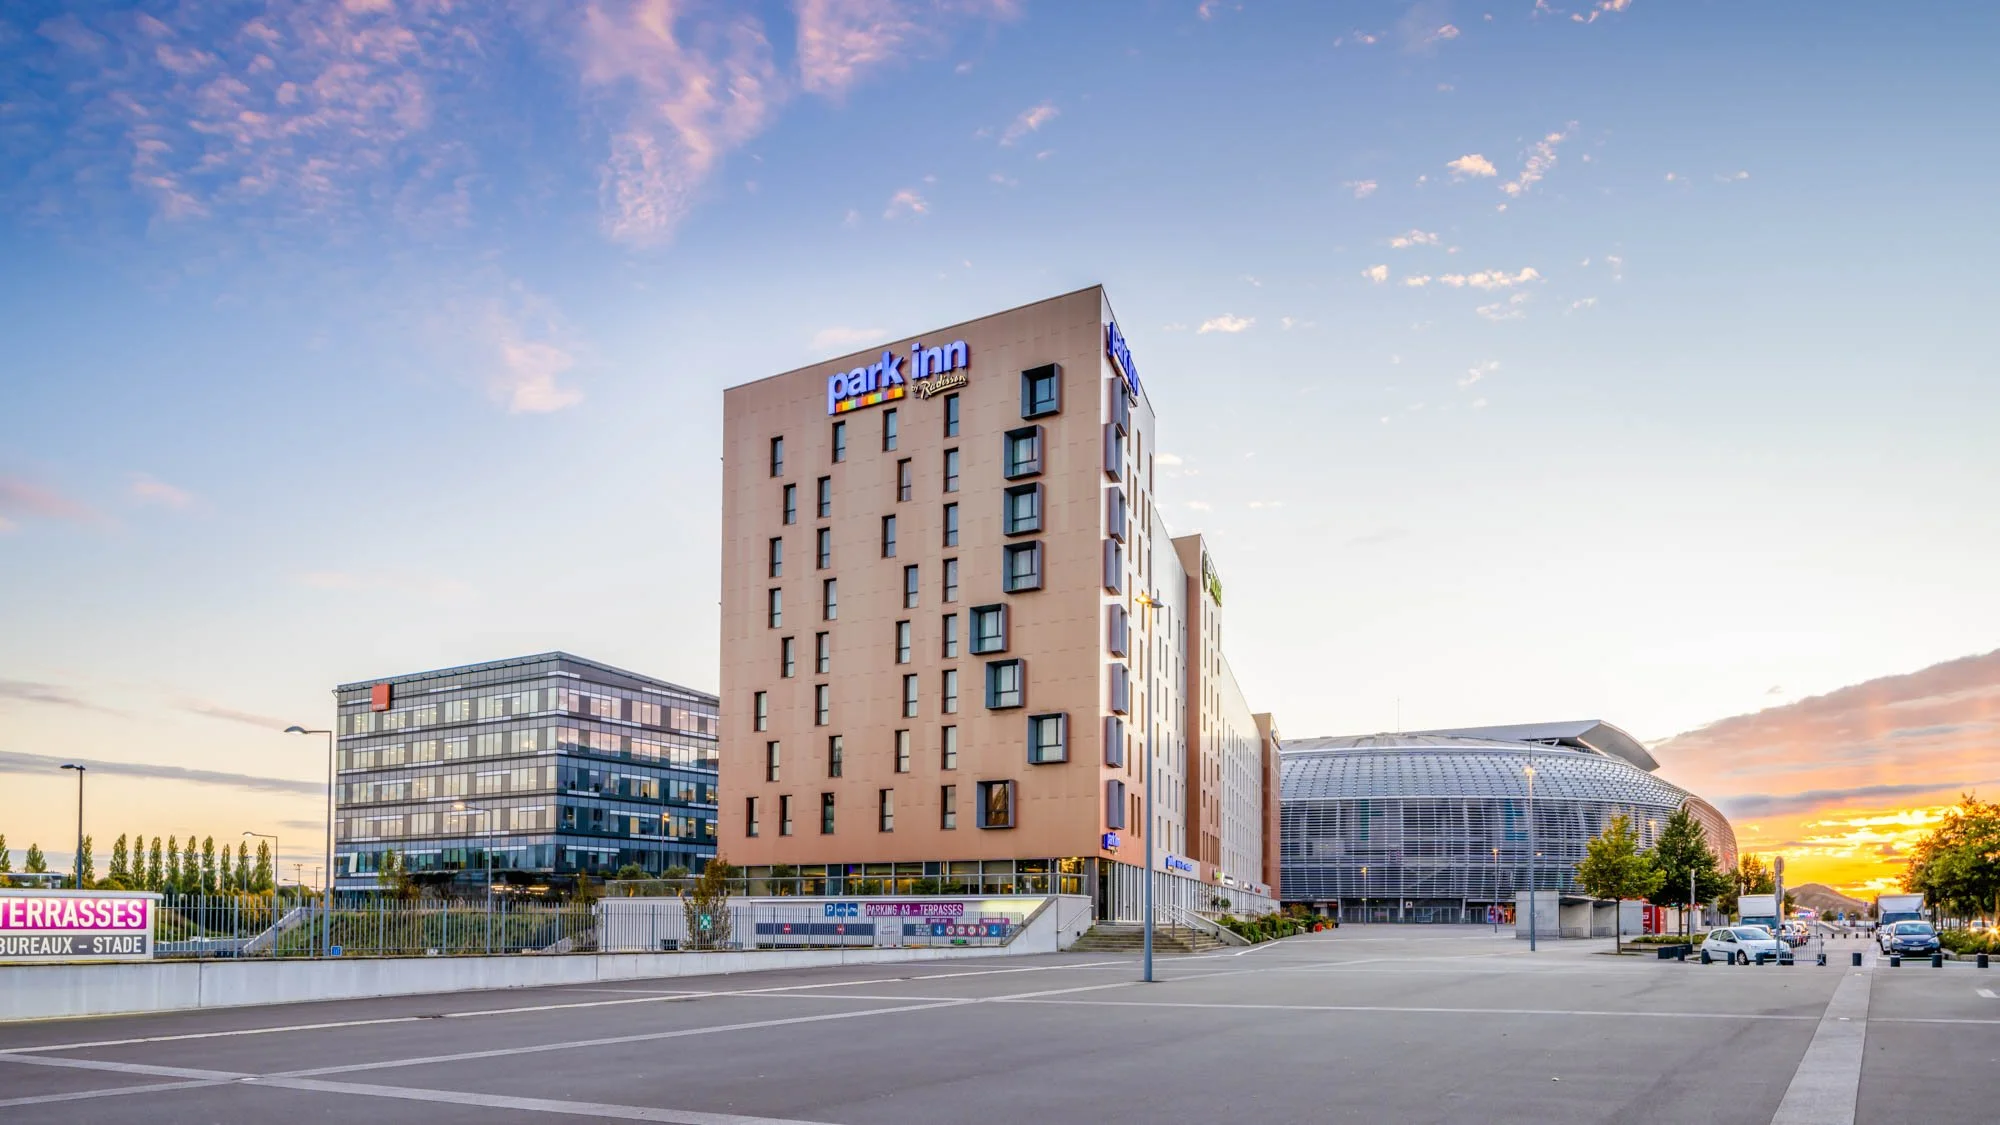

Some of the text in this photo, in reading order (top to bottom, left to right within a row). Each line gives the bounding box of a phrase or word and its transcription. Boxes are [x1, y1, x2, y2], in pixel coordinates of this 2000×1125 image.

[828, 340, 968, 415] park inn
[920, 374, 967, 399] Radisson
[866, 904, 897, 916] PARKING
[900, 904, 911, 916] A3
[920, 904, 963, 916] TERRASSES
[93, 936, 142, 953] STADE
